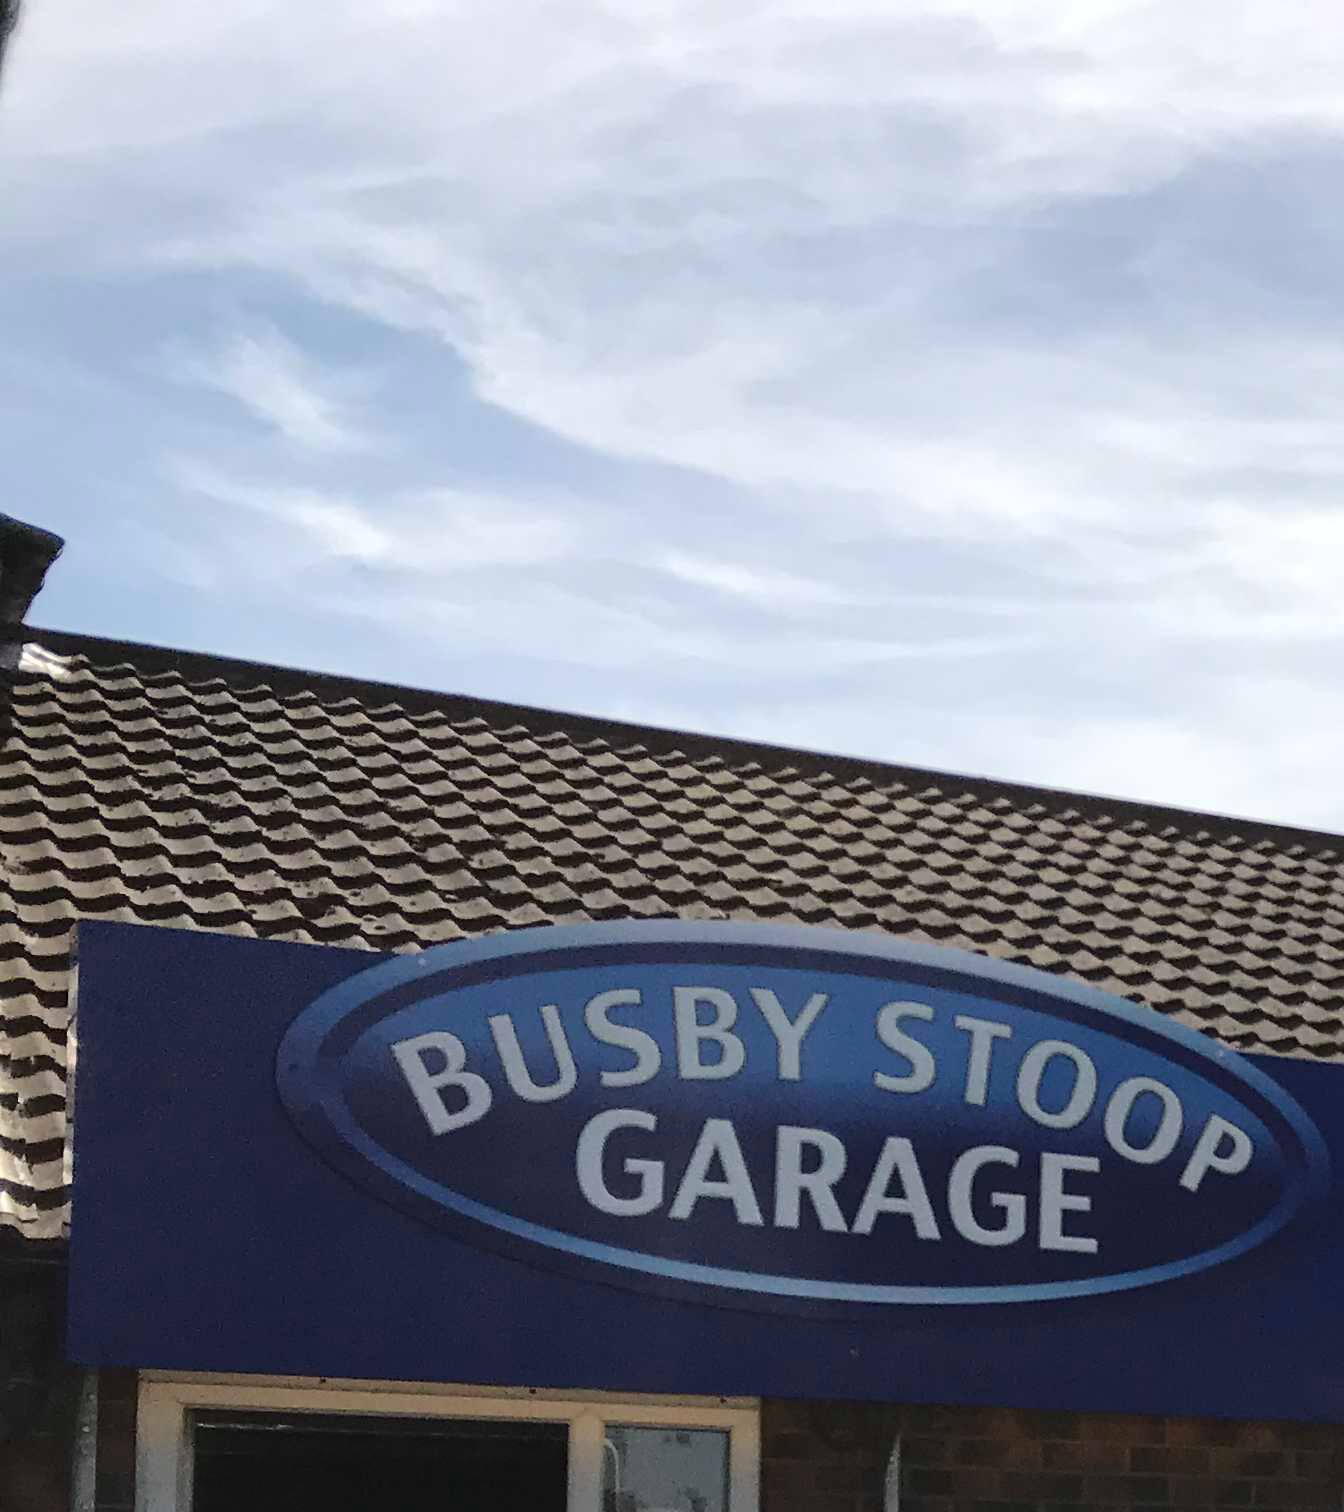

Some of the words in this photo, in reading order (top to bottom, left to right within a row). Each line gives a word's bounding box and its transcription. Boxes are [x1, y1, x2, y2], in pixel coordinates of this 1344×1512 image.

[391, 985, 830, 1137] BUSBY
[873, 998, 1255, 1194] STOOP
[575, 1109, 1102, 1255] GARAGE
